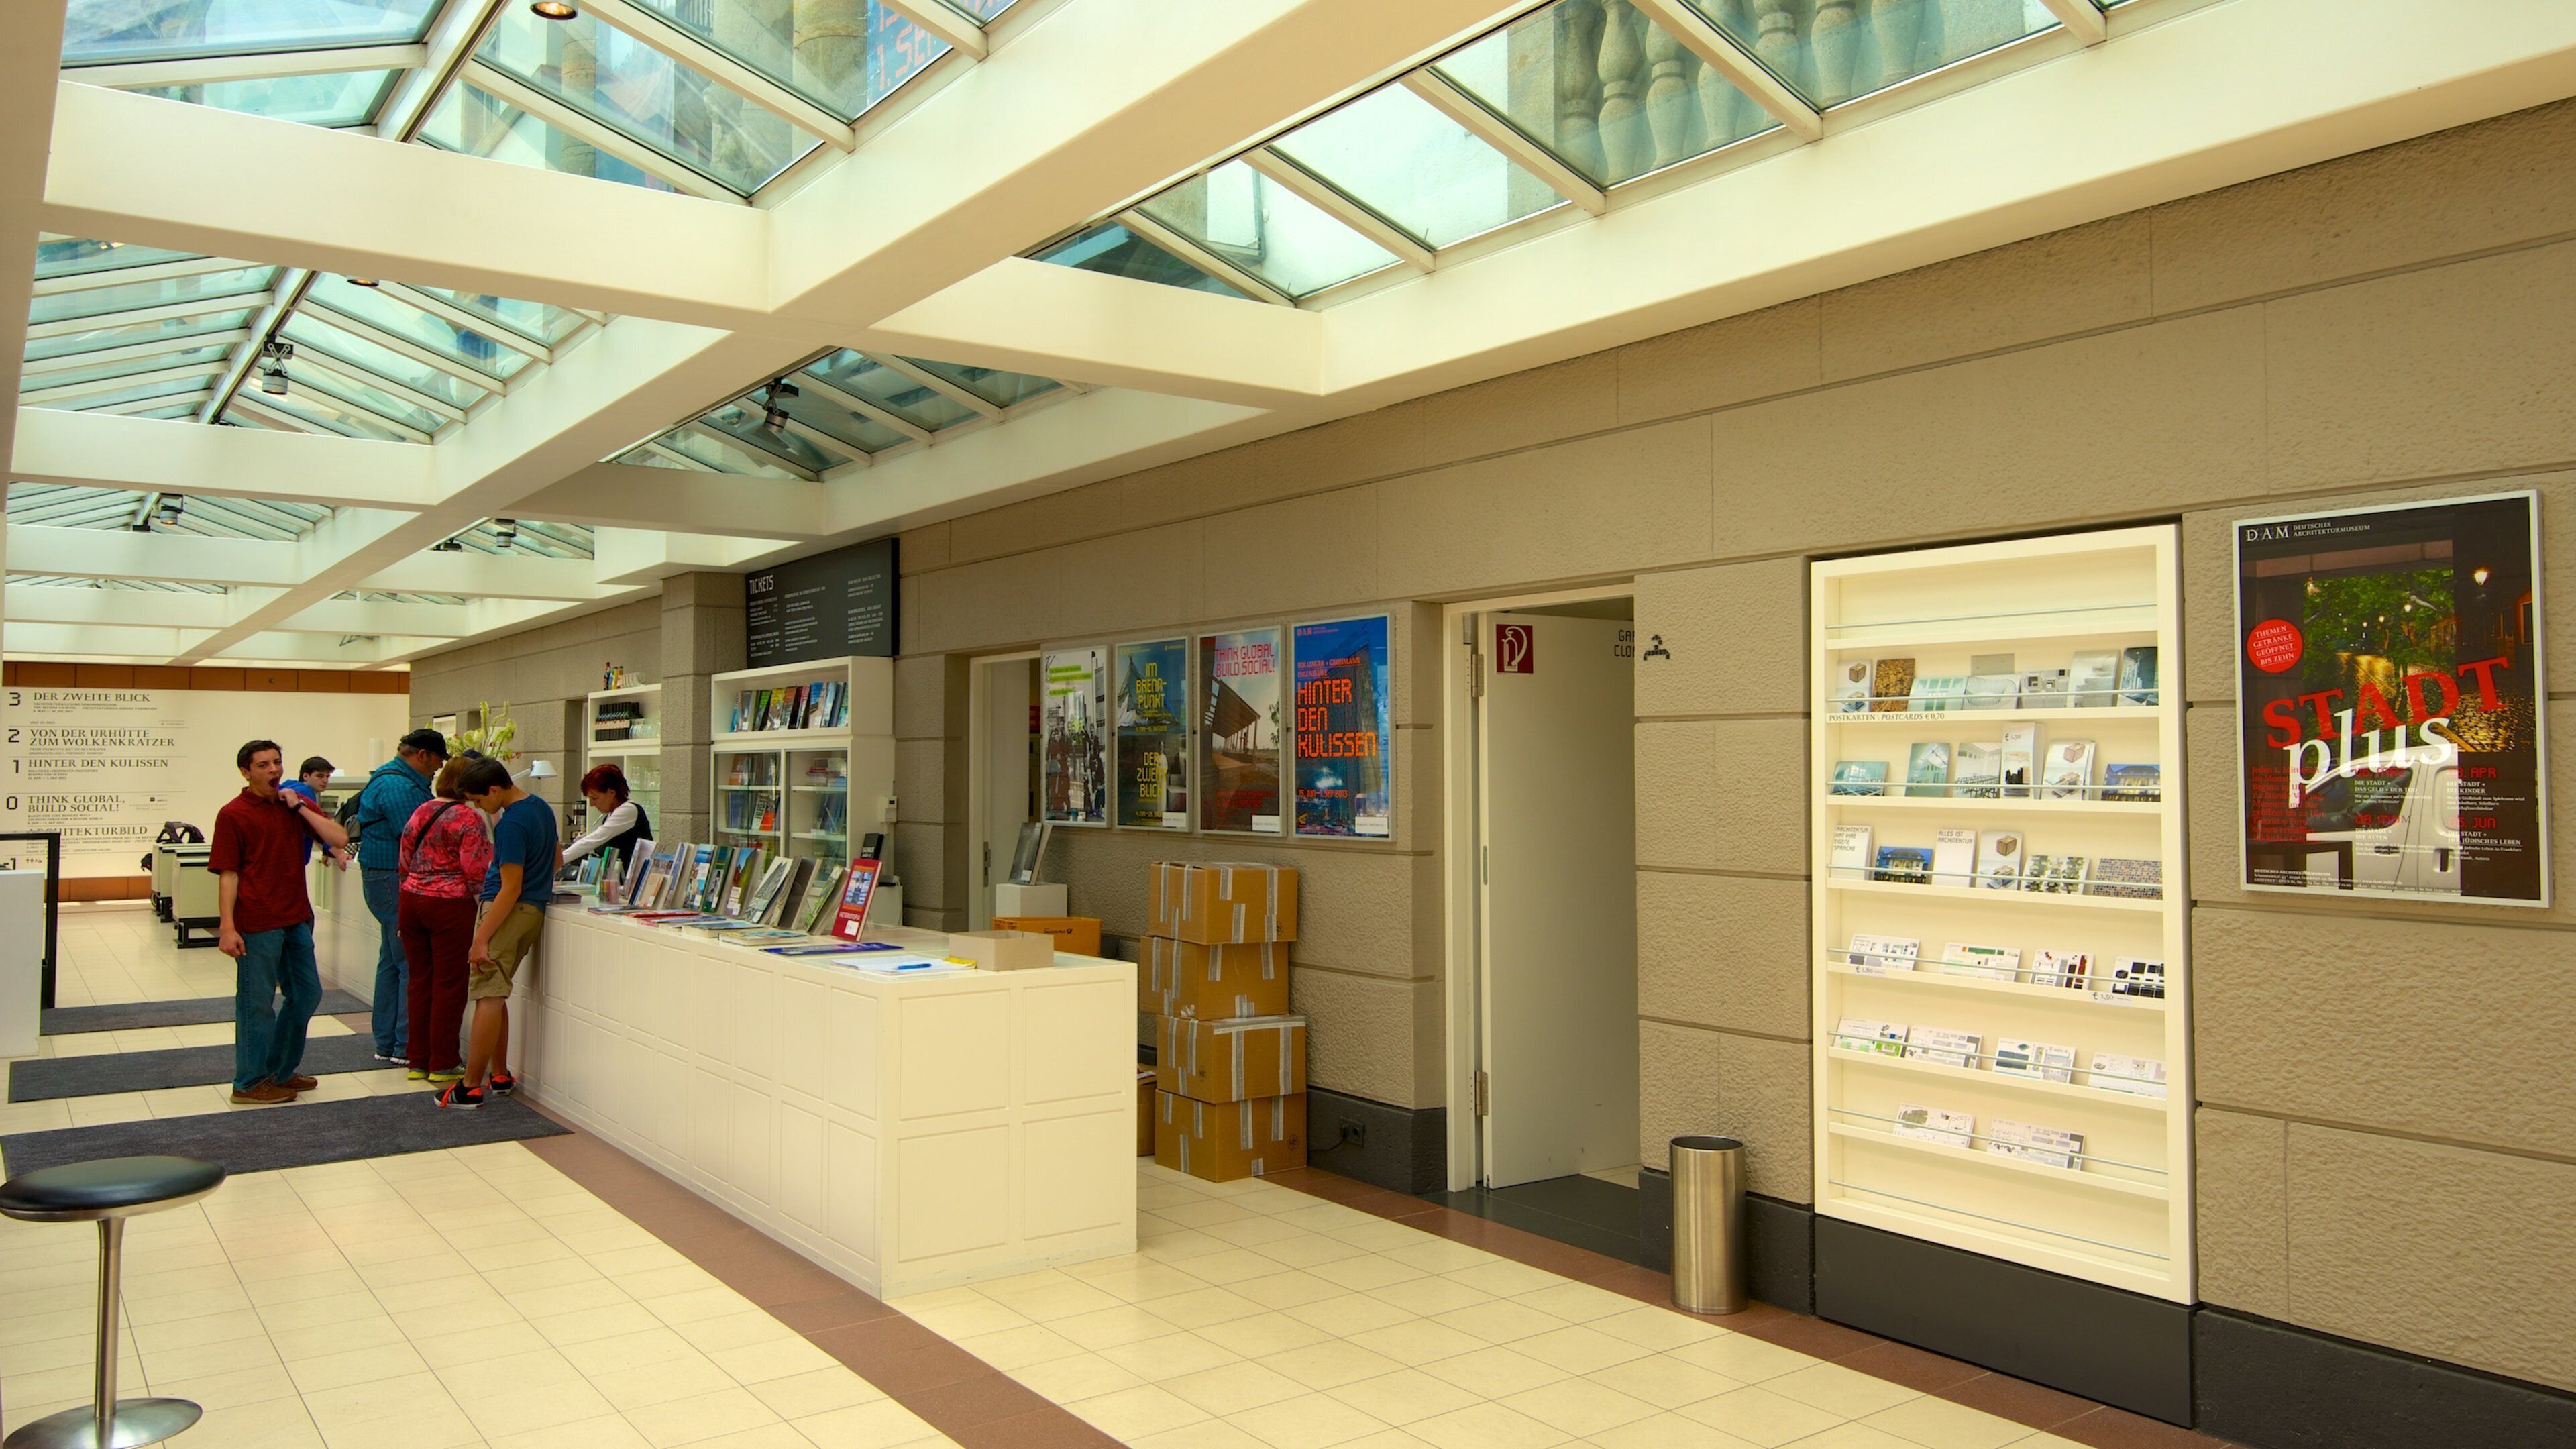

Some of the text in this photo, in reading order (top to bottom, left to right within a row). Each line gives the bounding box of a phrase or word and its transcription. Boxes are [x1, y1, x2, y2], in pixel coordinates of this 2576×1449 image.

[2246, 522, 2331, 541] DAM DEUTSCHES
[2293, 525, 2371, 537] ARCHITEKTURMUSEUM
[749, 574, 773, 594] TICKETS
[2255, 625, 2287, 637] THEMEN
[2253, 633, 2293, 648] GETRÄNKE
[1215, 643, 1274, 661] THINK GLOBAL
[2255, 643, 2294, 657] GEÖFFNET
[2260, 653, 2294, 665] BIS ZEHN
[1146, 663, 1157, 676] IM
[1216, 659, 1275, 677] BUILD SOCIAL!
[9, 692, 150, 706] 3 DER ZWEITE BLICK
[1297, 678, 1352, 705] HINTER
[1138, 693, 1165, 708] PUNKT
[2263, 656, 2510, 749] STADT
[1297, 706, 1328, 731] DEN
[8, 729, 19, 743] 2
[62, 729, 85, 737] DER
[90, 728, 150, 737] URHÜTTE
[30, 738, 175, 746] ZUM WOLKENKRATZER
[1297, 731, 1377, 757] KULISSEN
[13, 759, 168, 773] 1 HINTER DEN KULISSEN
[1144, 752, 1159, 765] DER
[2283, 708, 2451, 809] plus
[2471, 767, 2497, 777] APR
[6, 795, 125, 810] 0 THINK GLOBAL,
[28, 804, 119, 812] BUILD SOCIAL!
[2471, 817, 2496, 828] JUN
